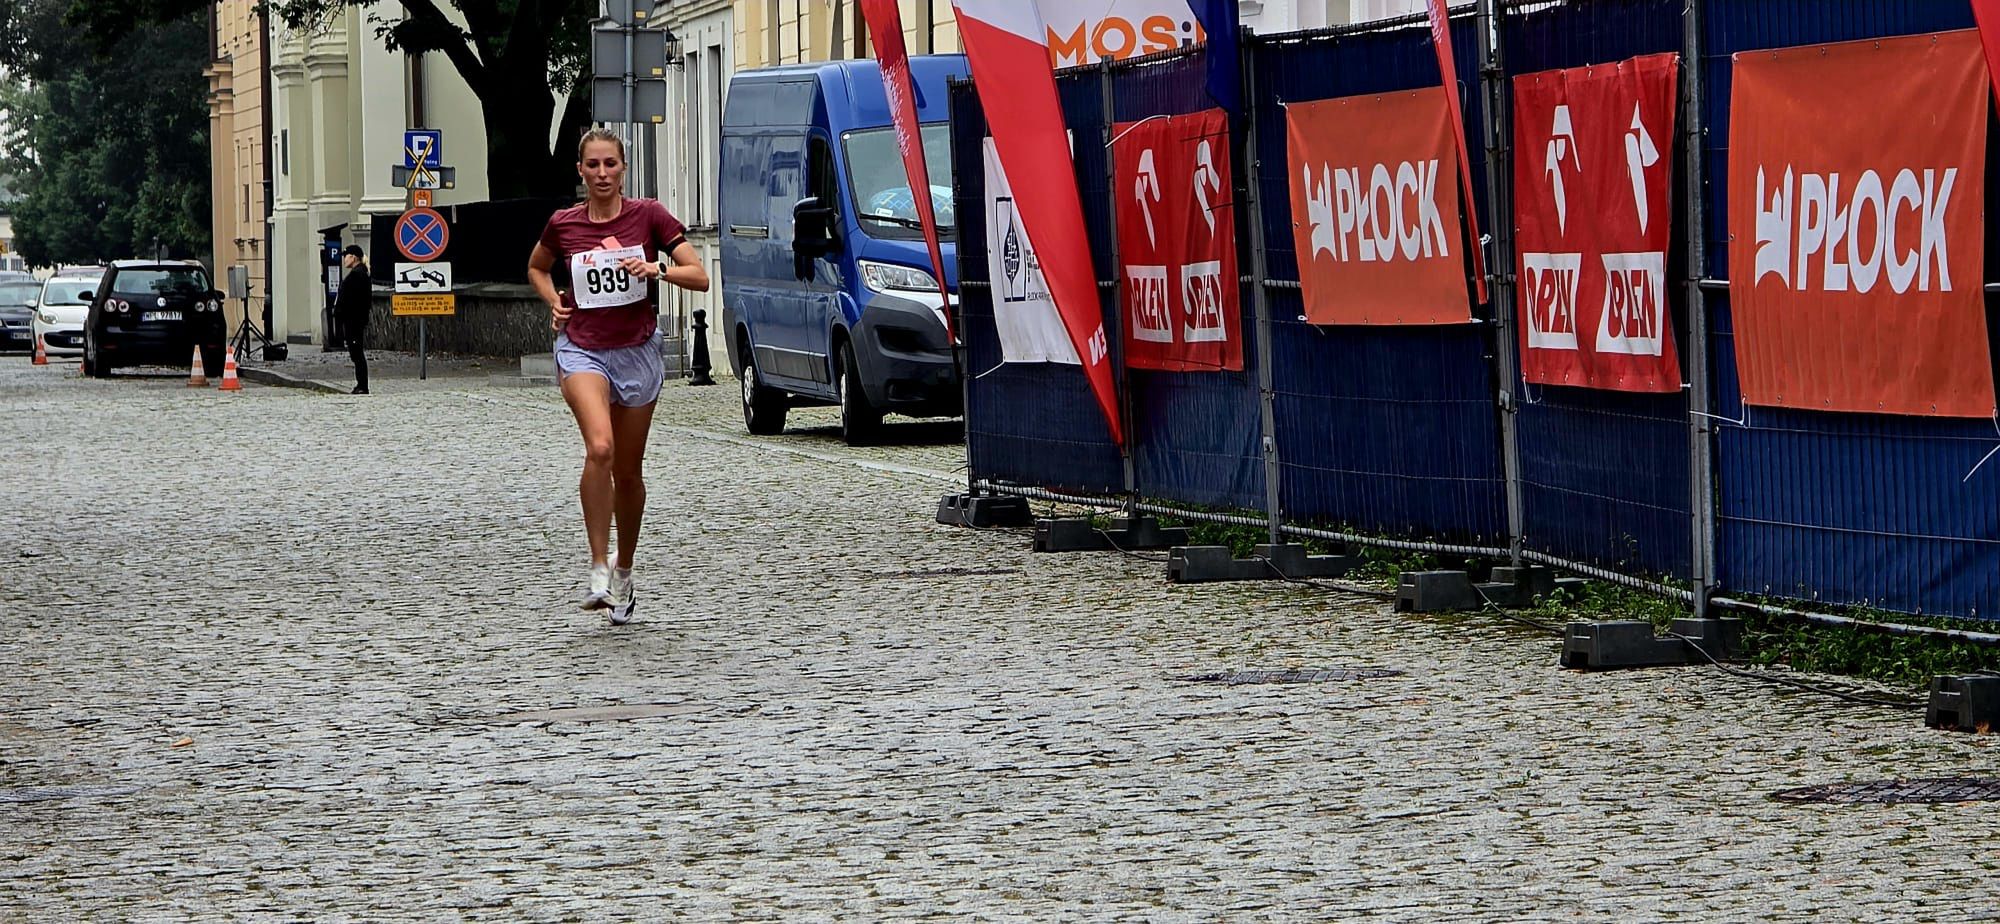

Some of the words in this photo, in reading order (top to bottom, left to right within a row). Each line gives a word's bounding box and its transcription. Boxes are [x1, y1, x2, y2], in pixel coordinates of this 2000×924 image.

[1334, 159, 1448, 262] PŁOCK
[1796, 167, 1958, 294] PŁOCK
[331, 248, 338, 259] P
[586, 267, 630, 294] 939
